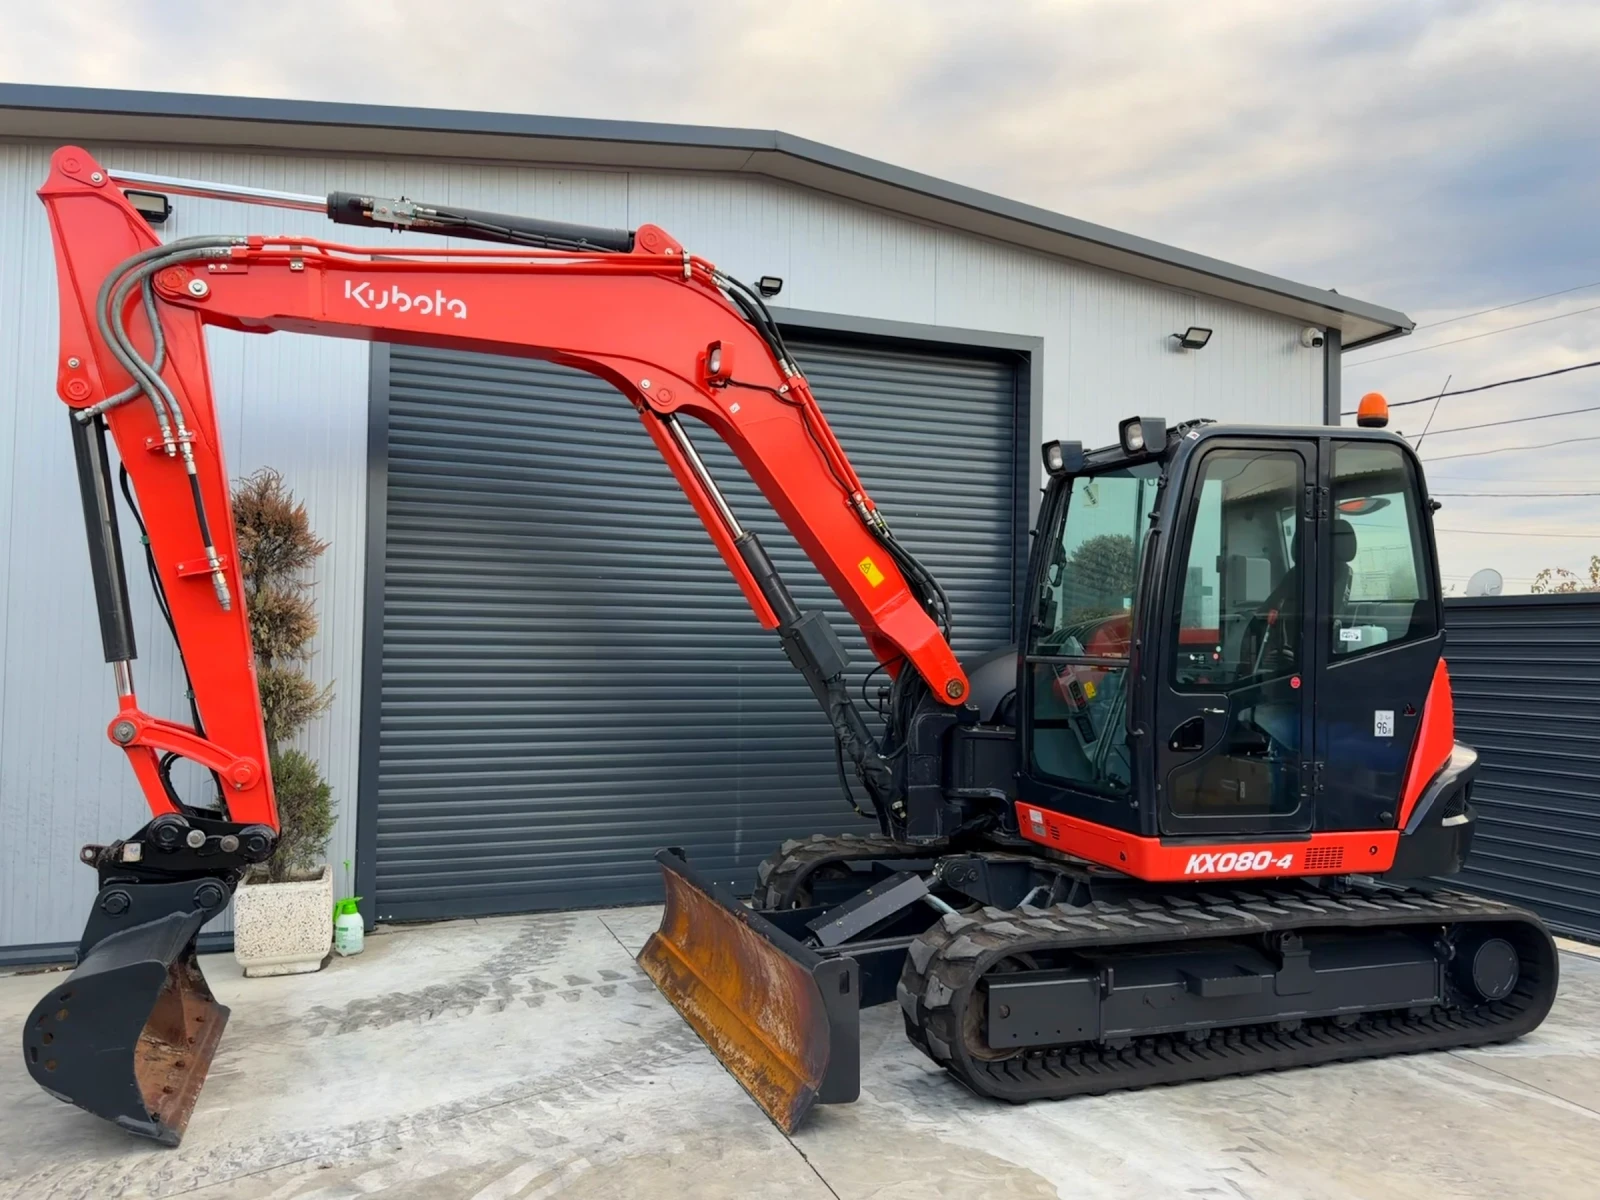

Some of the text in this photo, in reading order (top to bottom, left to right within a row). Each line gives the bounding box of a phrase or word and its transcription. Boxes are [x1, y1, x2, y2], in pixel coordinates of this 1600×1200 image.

[344, 279, 467, 319] Kubota
[1376, 721, 1388, 735] 96
[1184, 850, 1293, 875] KX080-4
